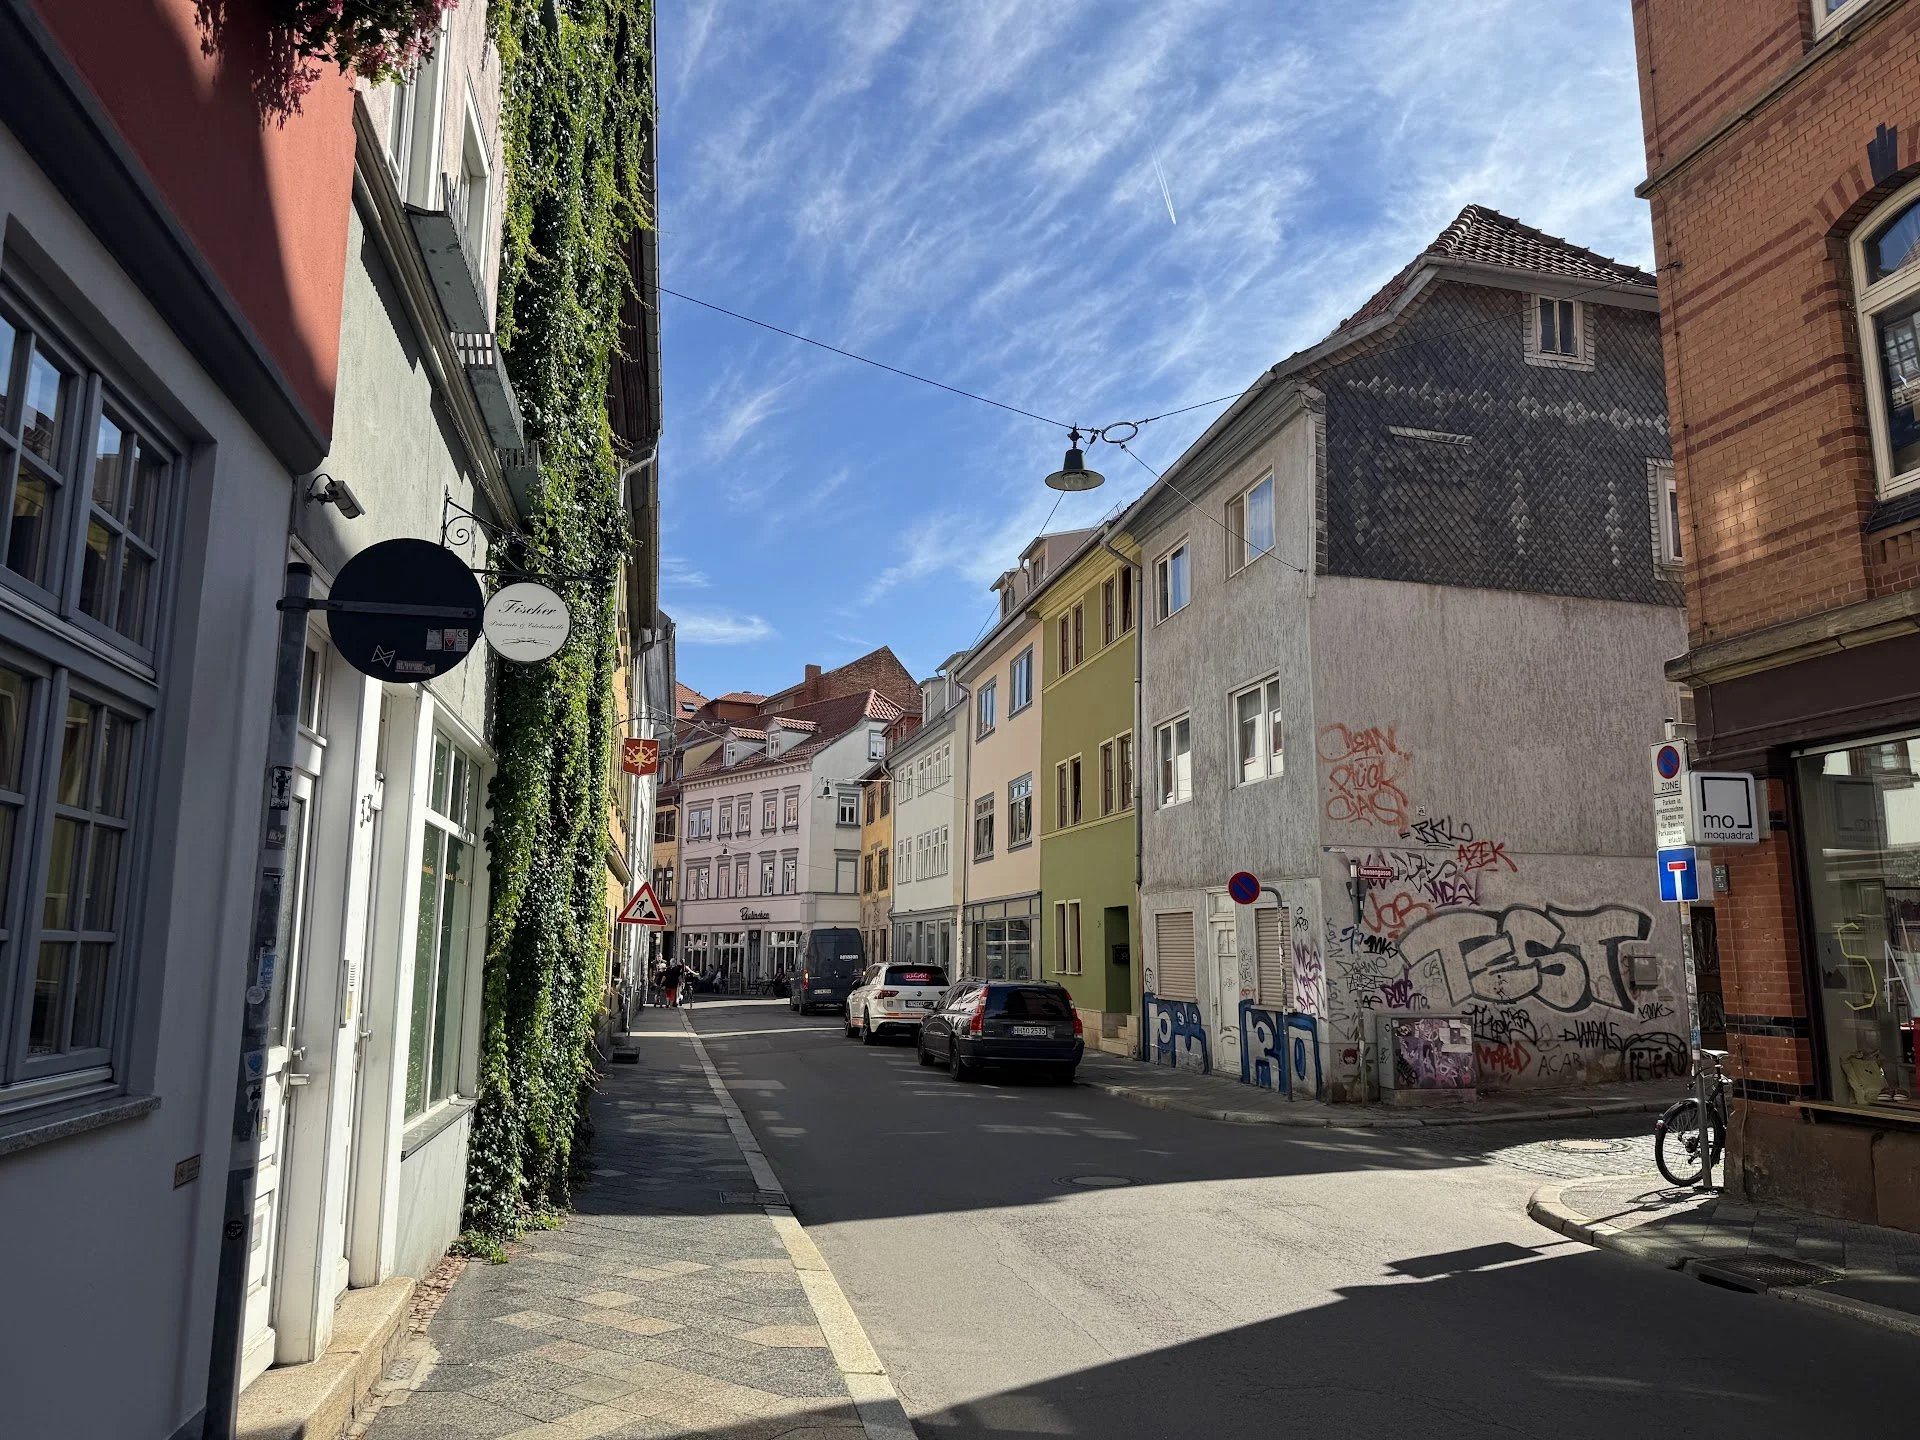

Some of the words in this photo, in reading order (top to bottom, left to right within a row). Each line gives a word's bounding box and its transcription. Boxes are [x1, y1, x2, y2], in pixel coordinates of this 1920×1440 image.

[498, 599, 557, 615] Fischer
[1661, 781, 1679, 790] ZONE
[1703, 815, 1734, 829] mo
[1704, 831, 1754, 840] moquadrat
[1399, 903, 1654, 1016] TEST
